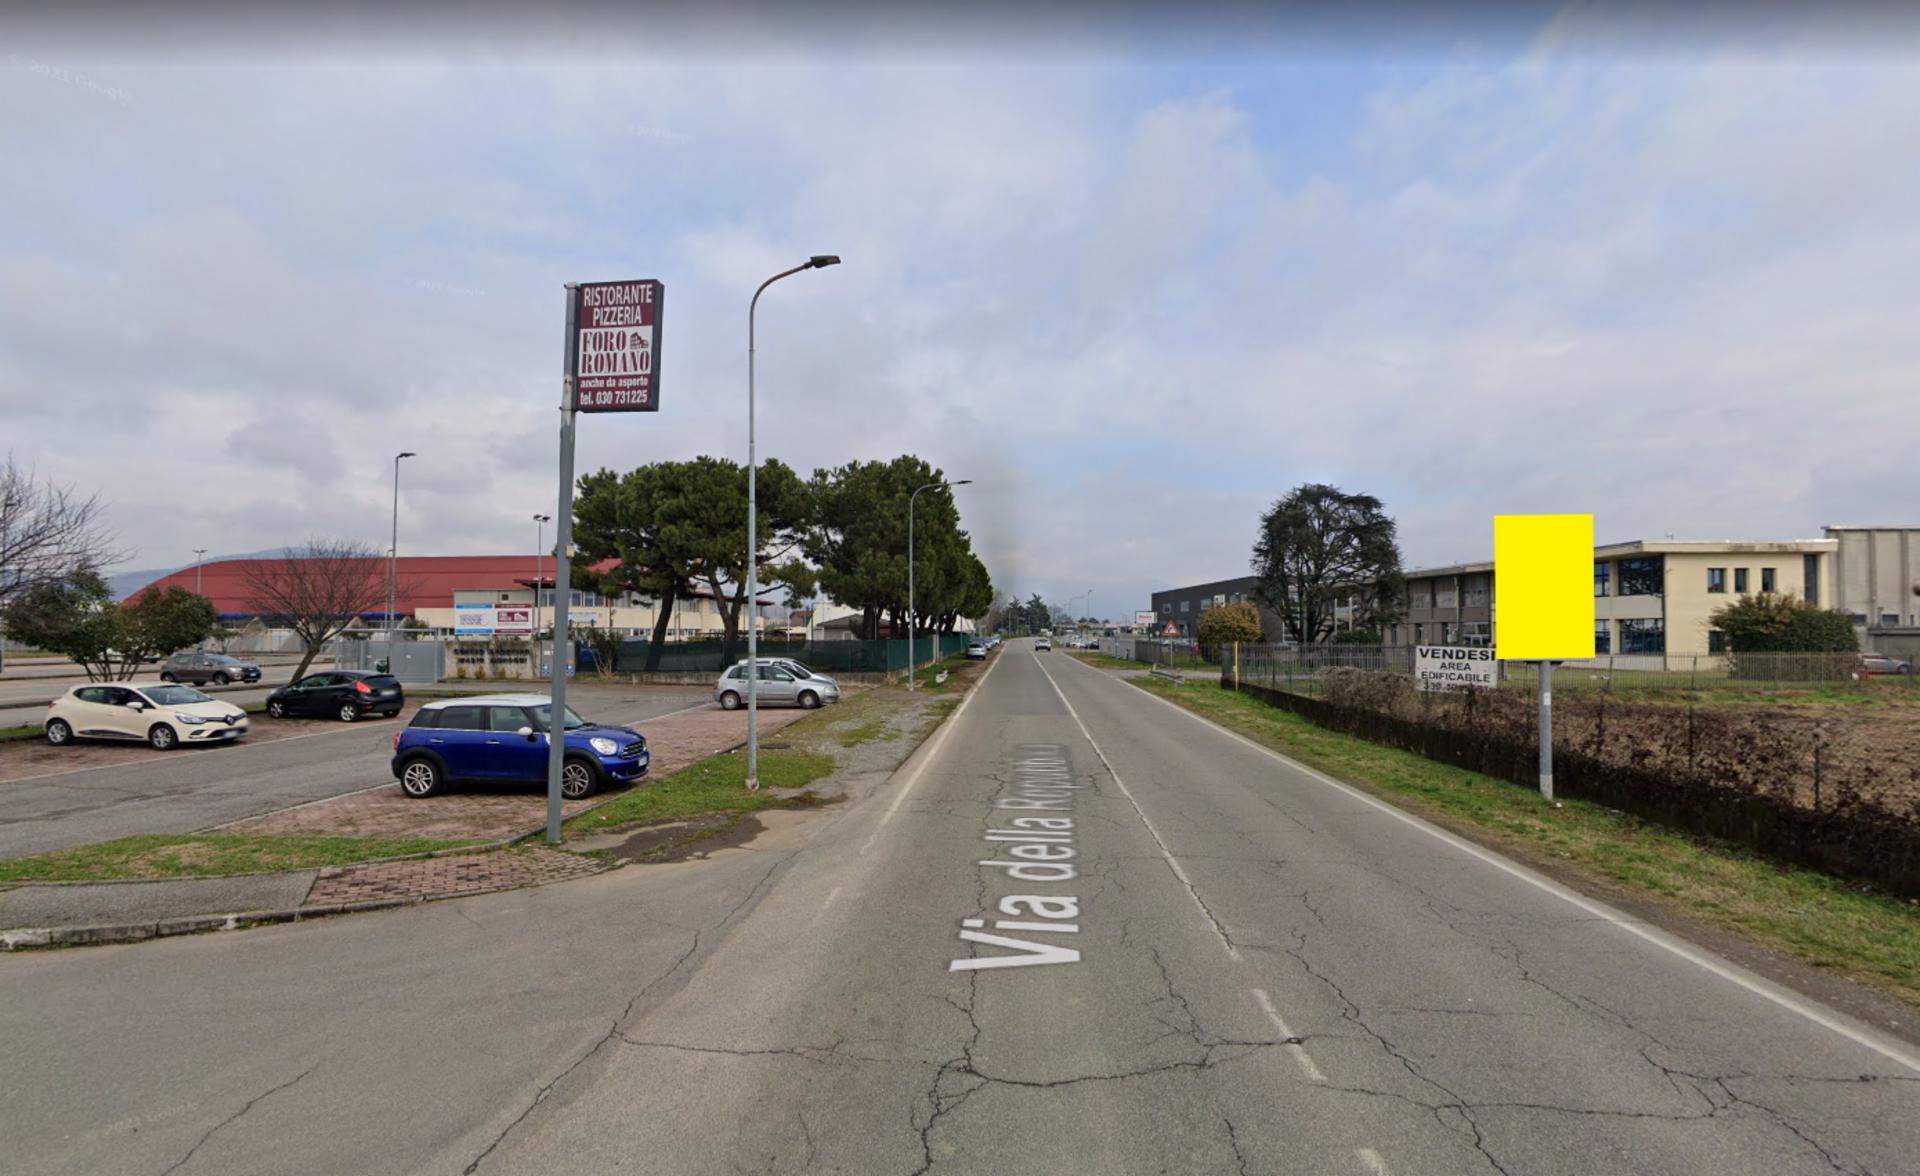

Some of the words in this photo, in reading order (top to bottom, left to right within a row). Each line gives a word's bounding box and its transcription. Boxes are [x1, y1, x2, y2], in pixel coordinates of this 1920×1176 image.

[584, 284, 653, 307] RISTORANTE
[592, 306, 642, 326] PIZZERIA
[582, 331, 627, 352] FORO
[581, 351, 650, 374] ROMANO
[580, 378, 605, 389] anche
[606, 377, 617, 388] da
[618, 376, 649, 388] asporto
[596, 390, 612, 404] 030
[615, 389, 648, 404] 731225
[1419, 647, 1496, 662] VENDESI
[1440, 661, 1472, 671] AREA
[1421, 671, 1491, 683] EDIFICABILE
